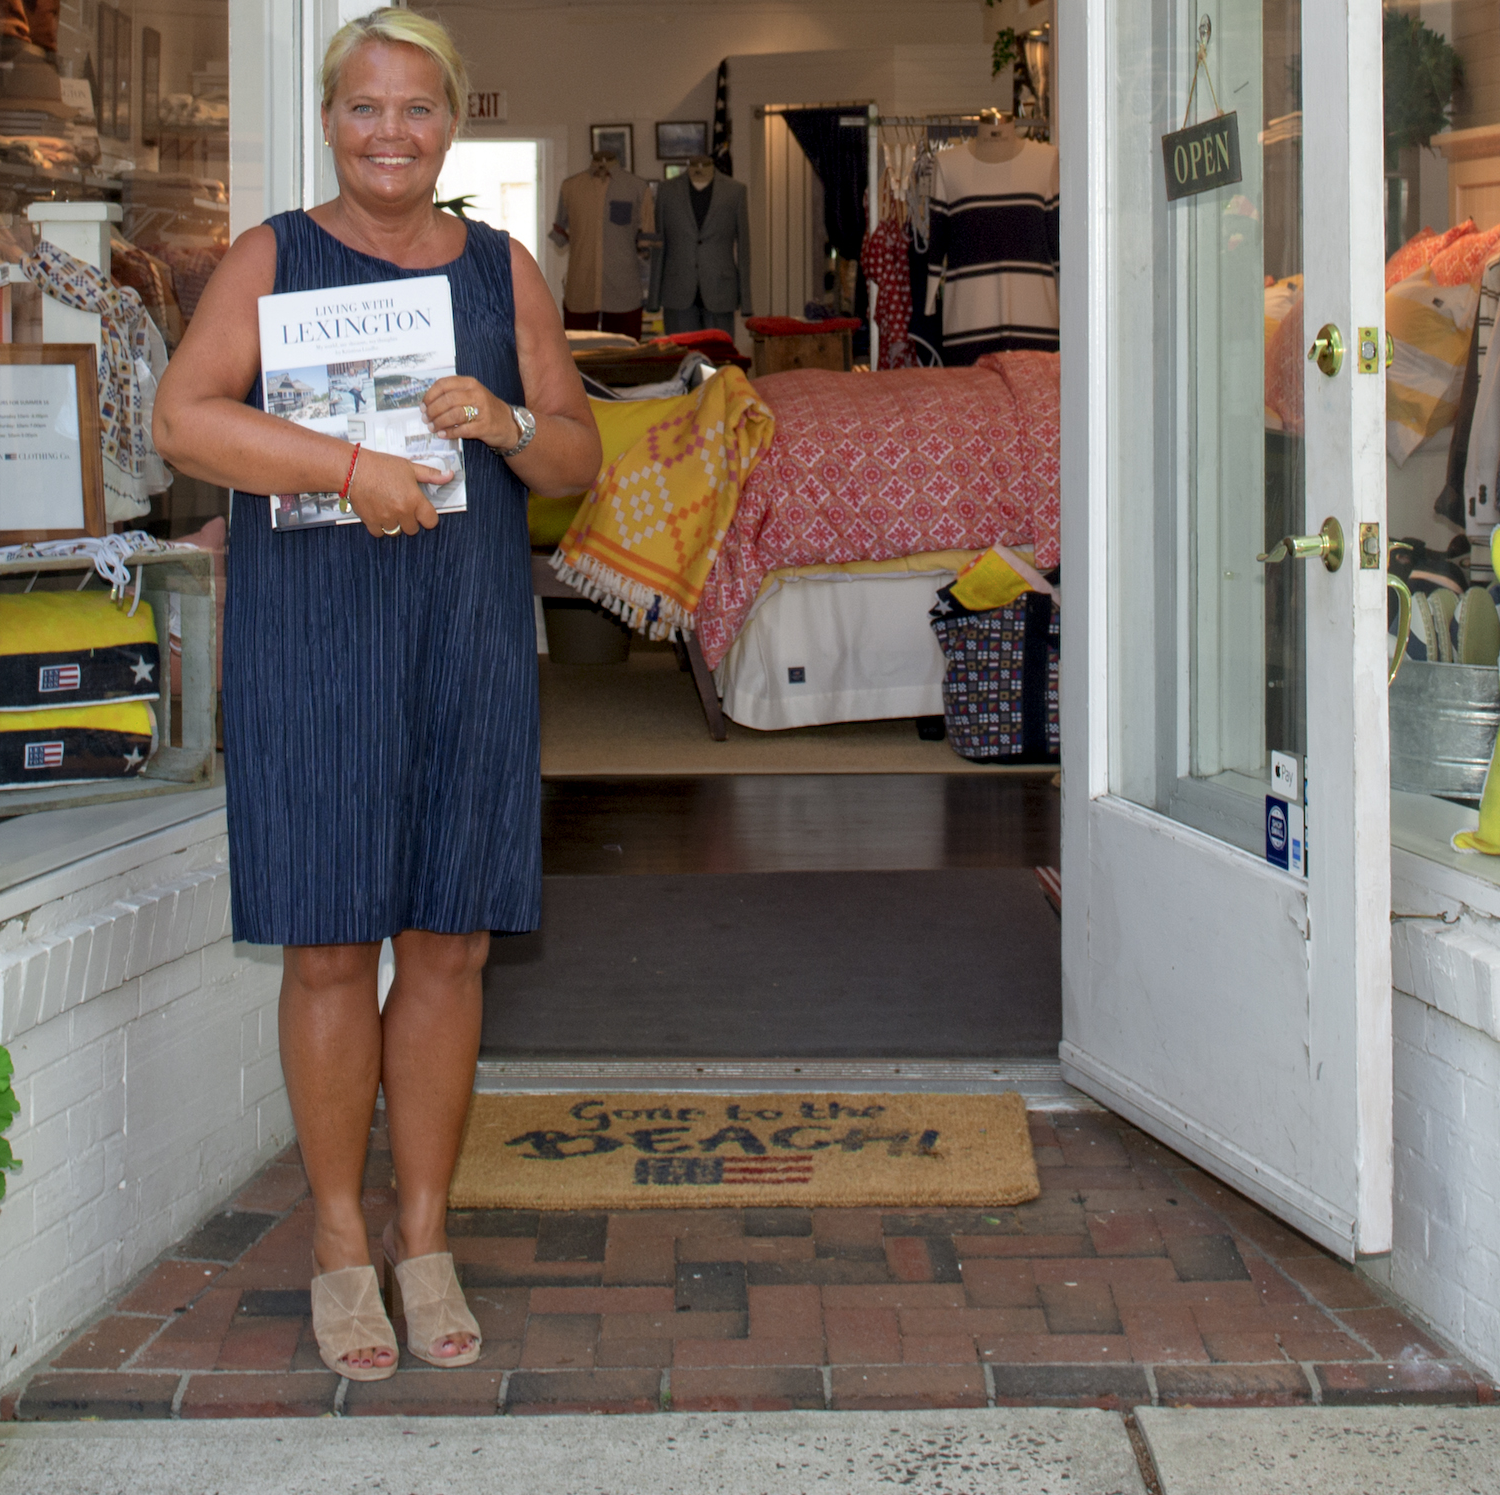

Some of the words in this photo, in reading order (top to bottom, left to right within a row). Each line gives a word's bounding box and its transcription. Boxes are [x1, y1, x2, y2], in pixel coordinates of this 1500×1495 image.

[468, 92, 500, 117] EXIT
[1174, 131, 1230, 184] OPEN
[316, 303, 357, 316] LIVING
[362, 298, 394, 311] WITH
[282, 308, 432, 345] LEXINGTON
[1281, 764, 1294, 787] Pay
[570, 1101, 702, 1132] Gone
[726, 1104, 783, 1122] to
[800, 1102, 885, 1120] the
